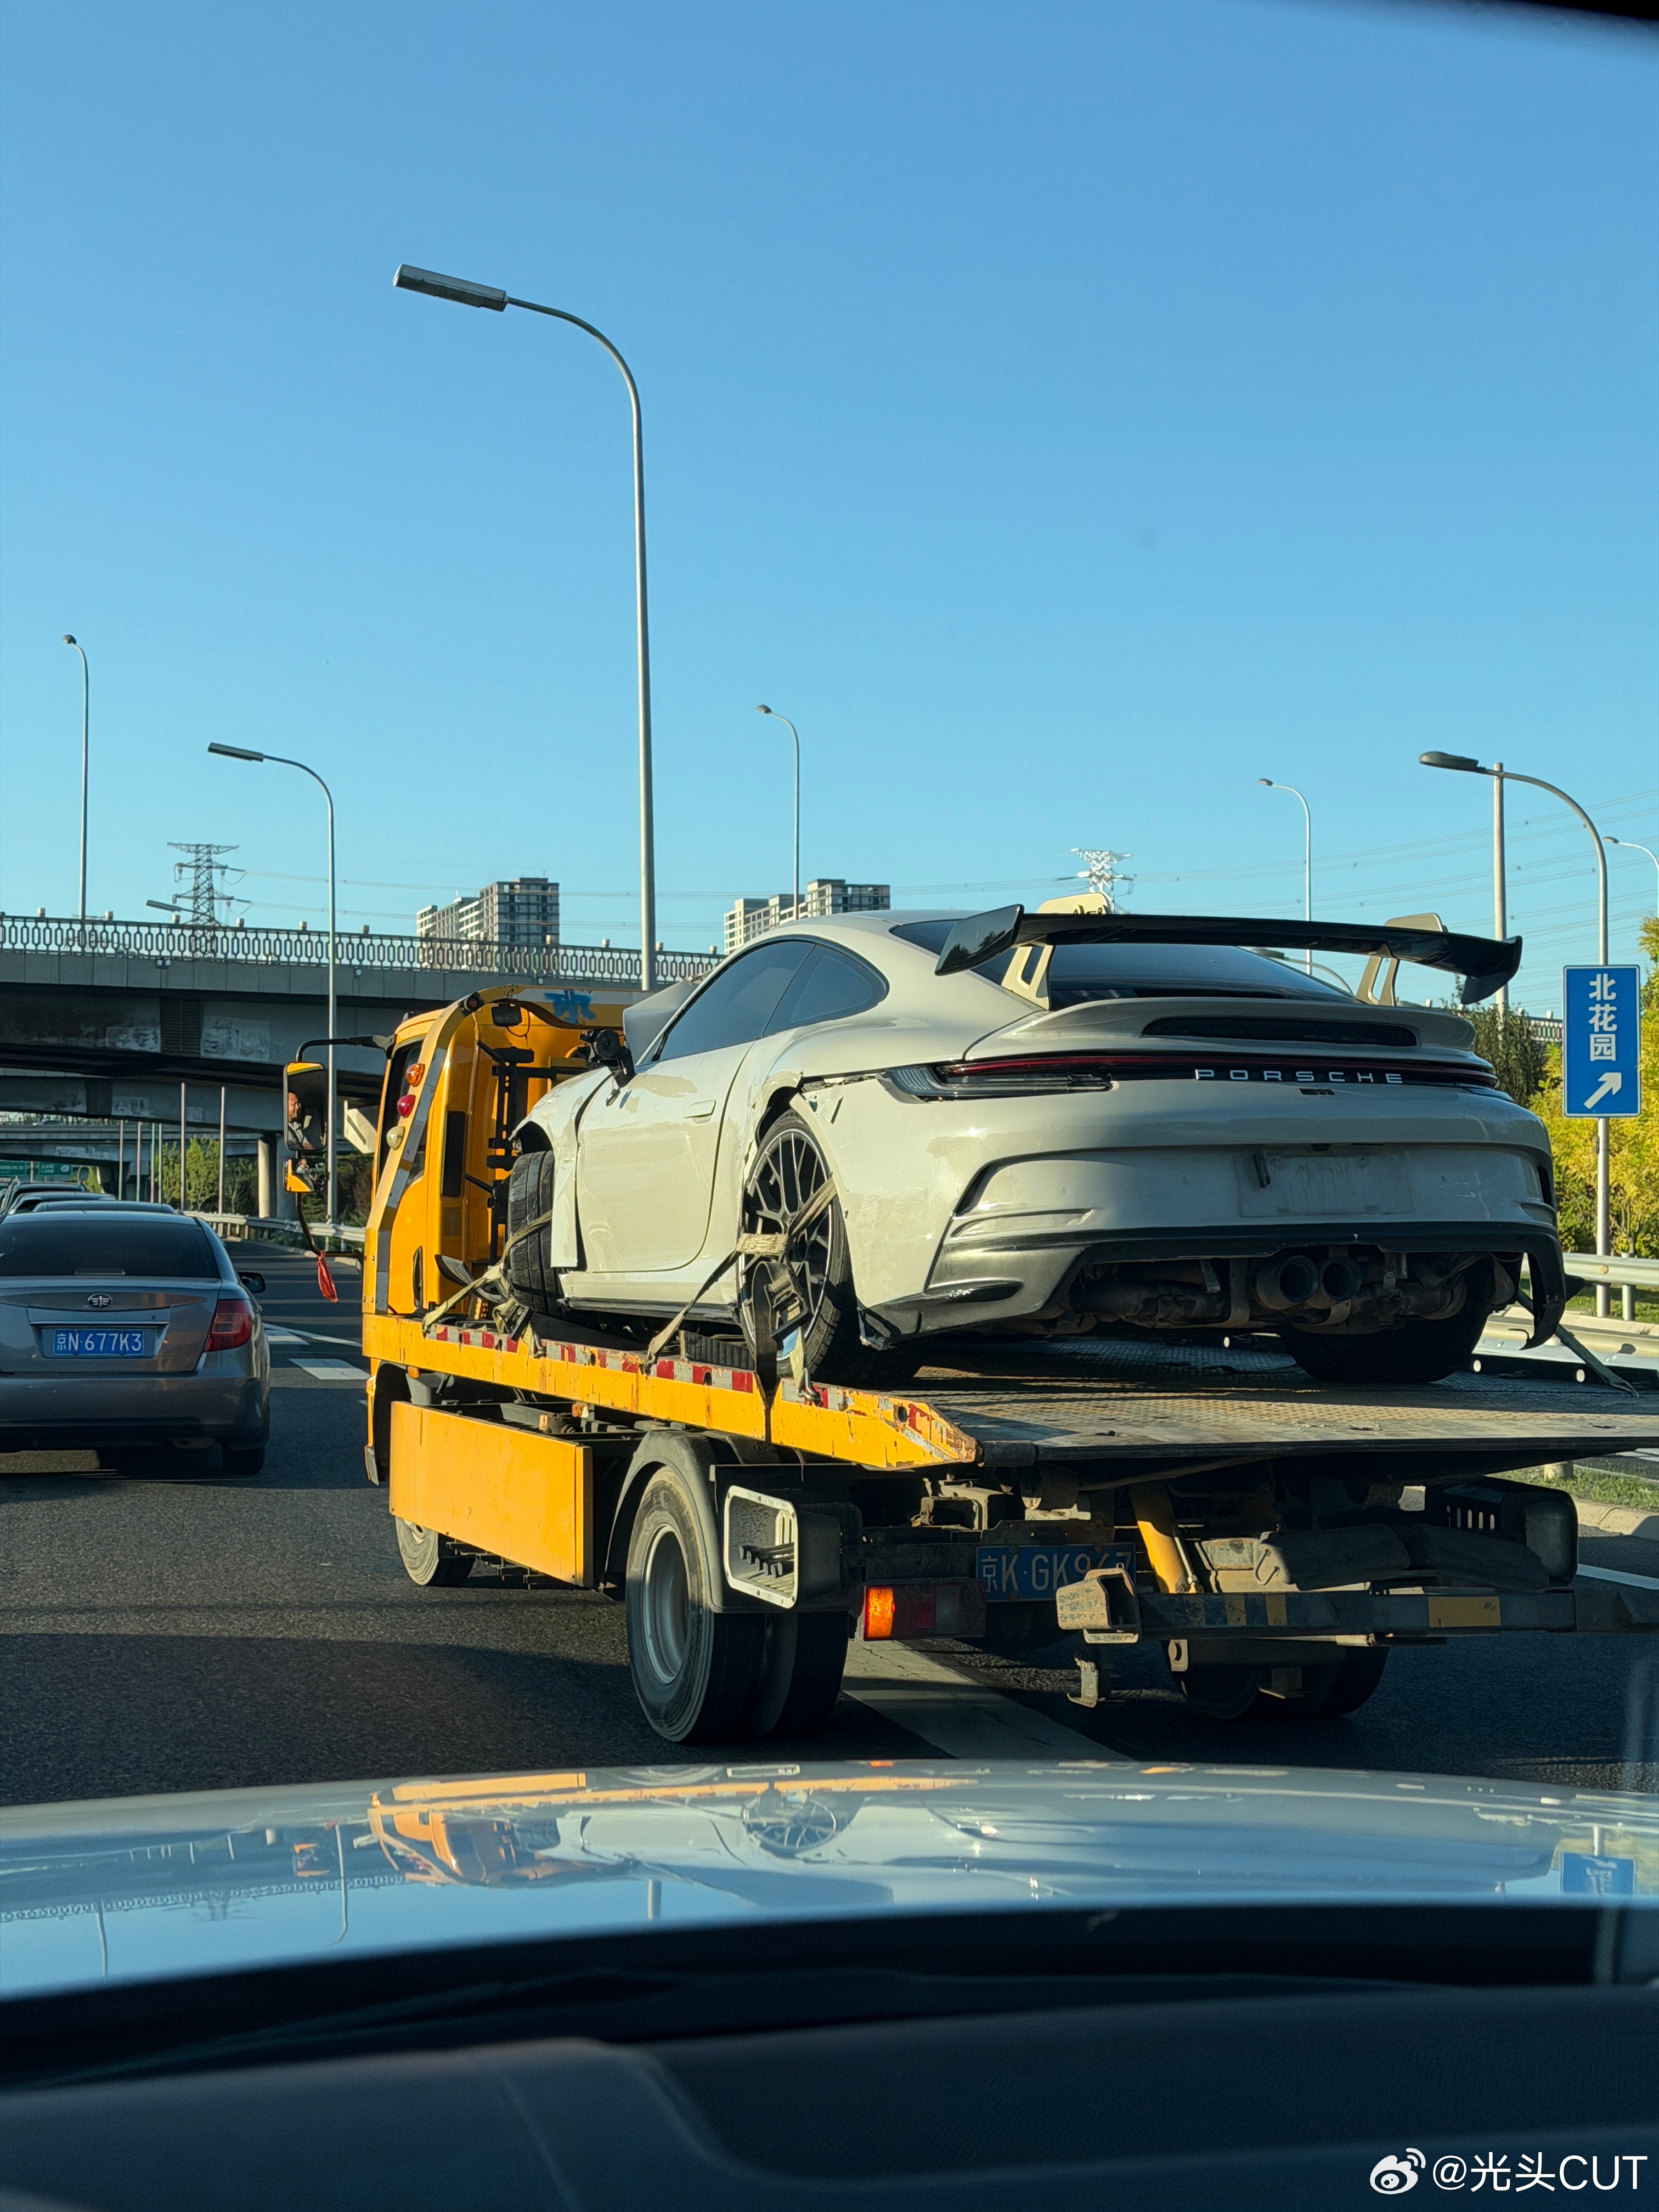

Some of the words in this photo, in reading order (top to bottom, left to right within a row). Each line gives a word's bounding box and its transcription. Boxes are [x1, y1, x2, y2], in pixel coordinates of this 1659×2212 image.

[1588, 973, 1617, 1062] 北花园
[1194, 1068, 1403, 1084] PORSCHE
